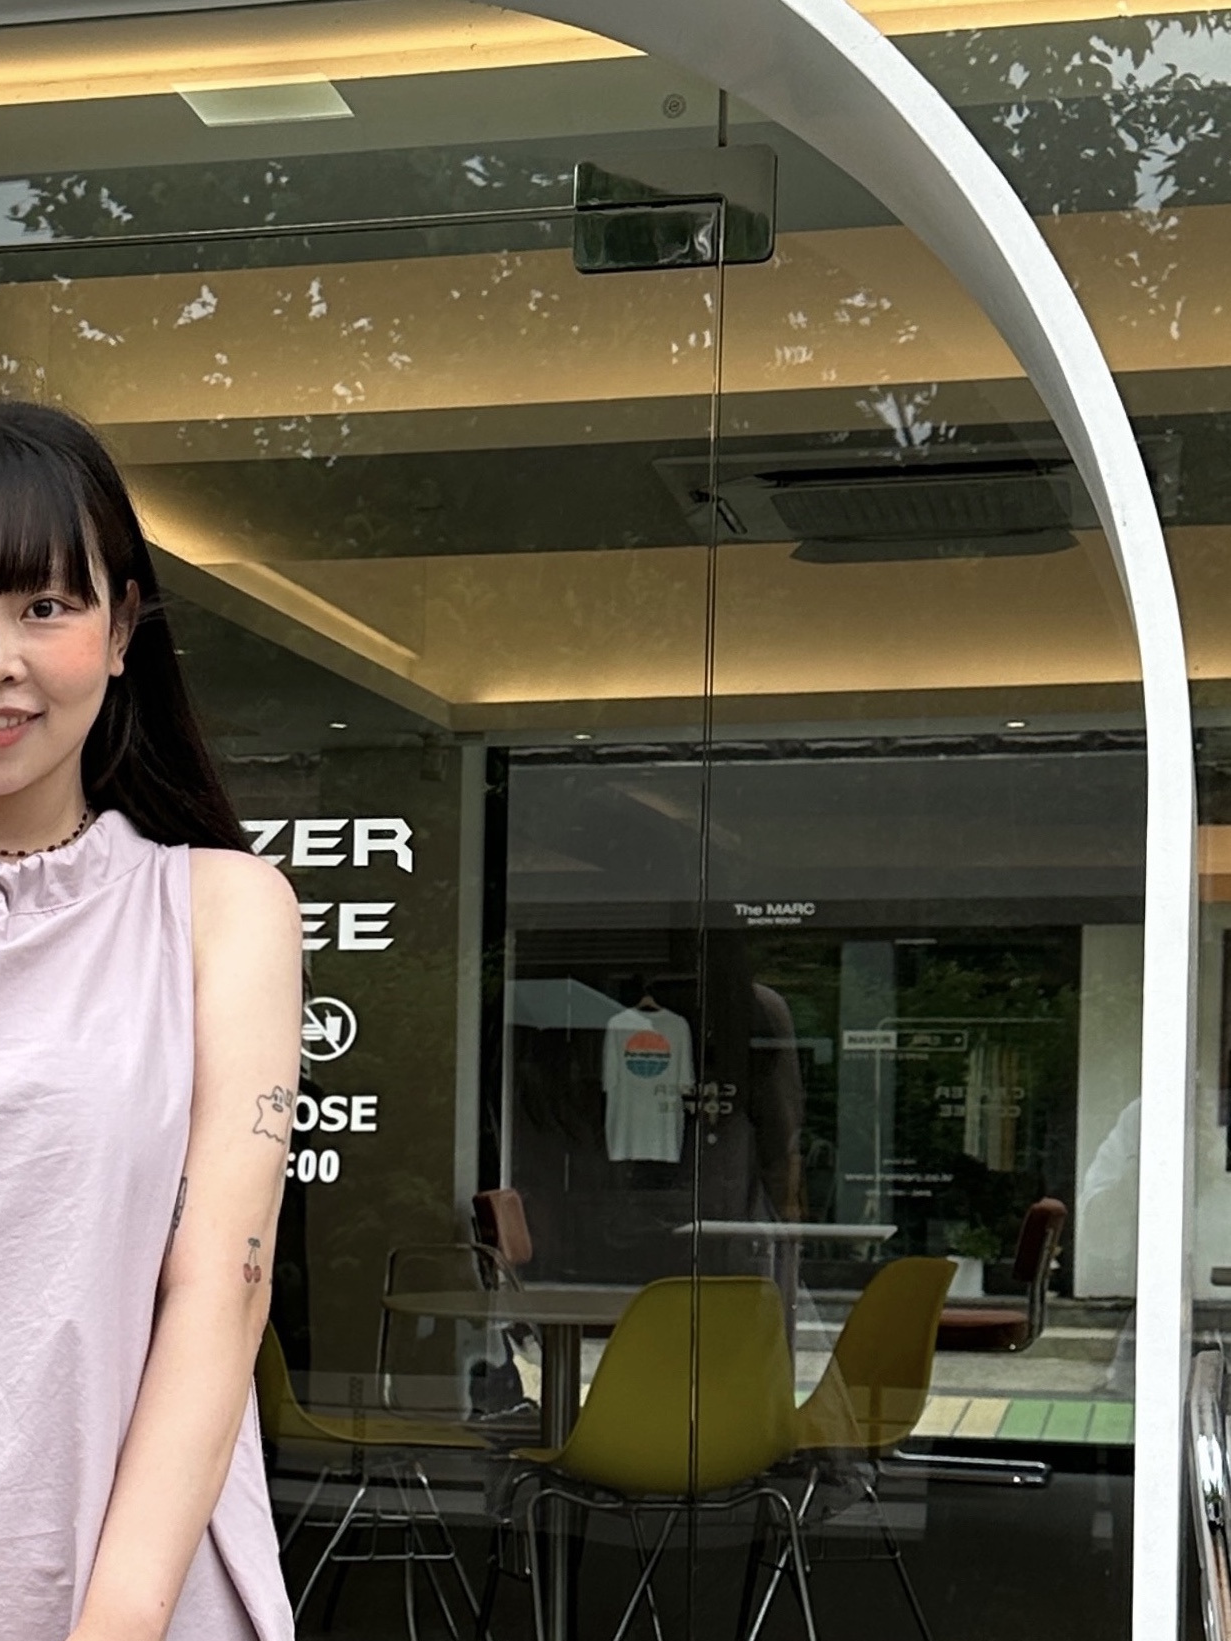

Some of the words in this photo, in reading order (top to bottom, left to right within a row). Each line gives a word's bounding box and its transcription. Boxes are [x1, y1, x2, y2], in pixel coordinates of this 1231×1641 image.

[239, 818, 413, 873] ZER
[298, 902, 396, 951] EE
[734, 903, 763, 916] The
[766, 902, 816, 916] MARC
[292, 1094, 378, 1132] OSE
[286, 1149, 340, 1183] :00
